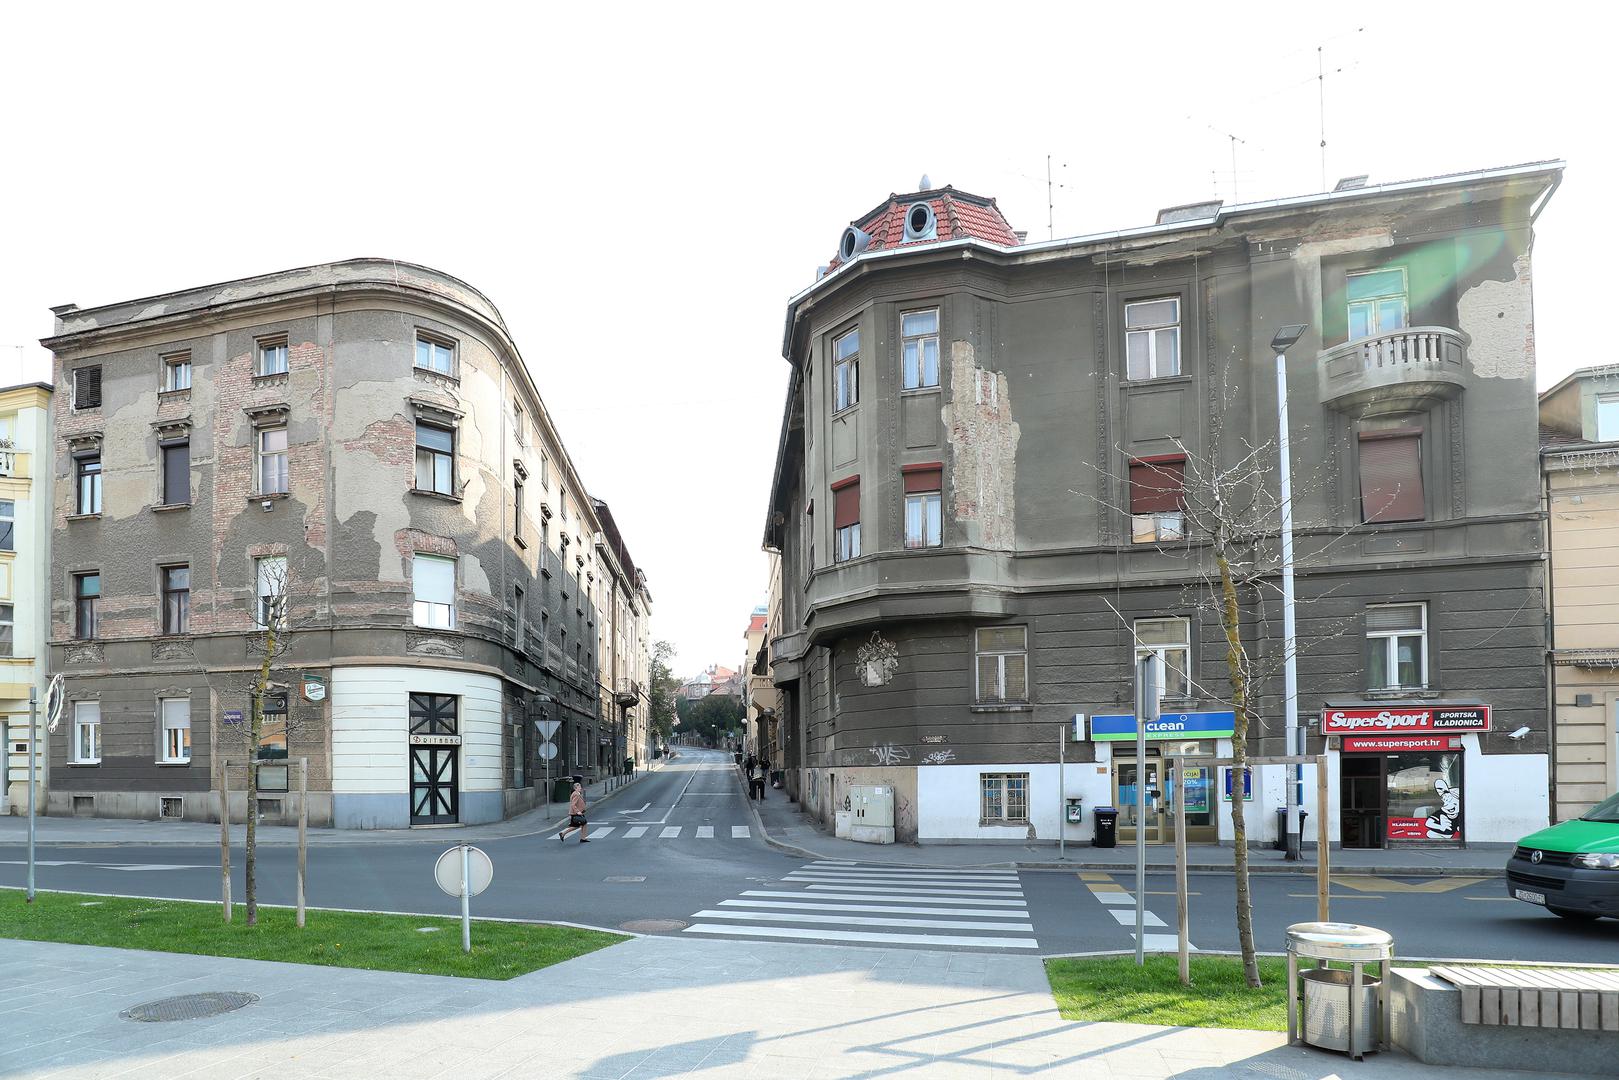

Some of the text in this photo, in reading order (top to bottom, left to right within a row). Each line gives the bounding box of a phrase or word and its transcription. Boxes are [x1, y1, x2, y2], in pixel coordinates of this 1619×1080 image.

[1440, 711, 1477, 719] SPORTSKA
[1328, 711, 1430, 730] SuperSport
[1433, 719, 1484, 727] KLADIONICA
[1353, 739, 1440, 748] www.supersport.hr
